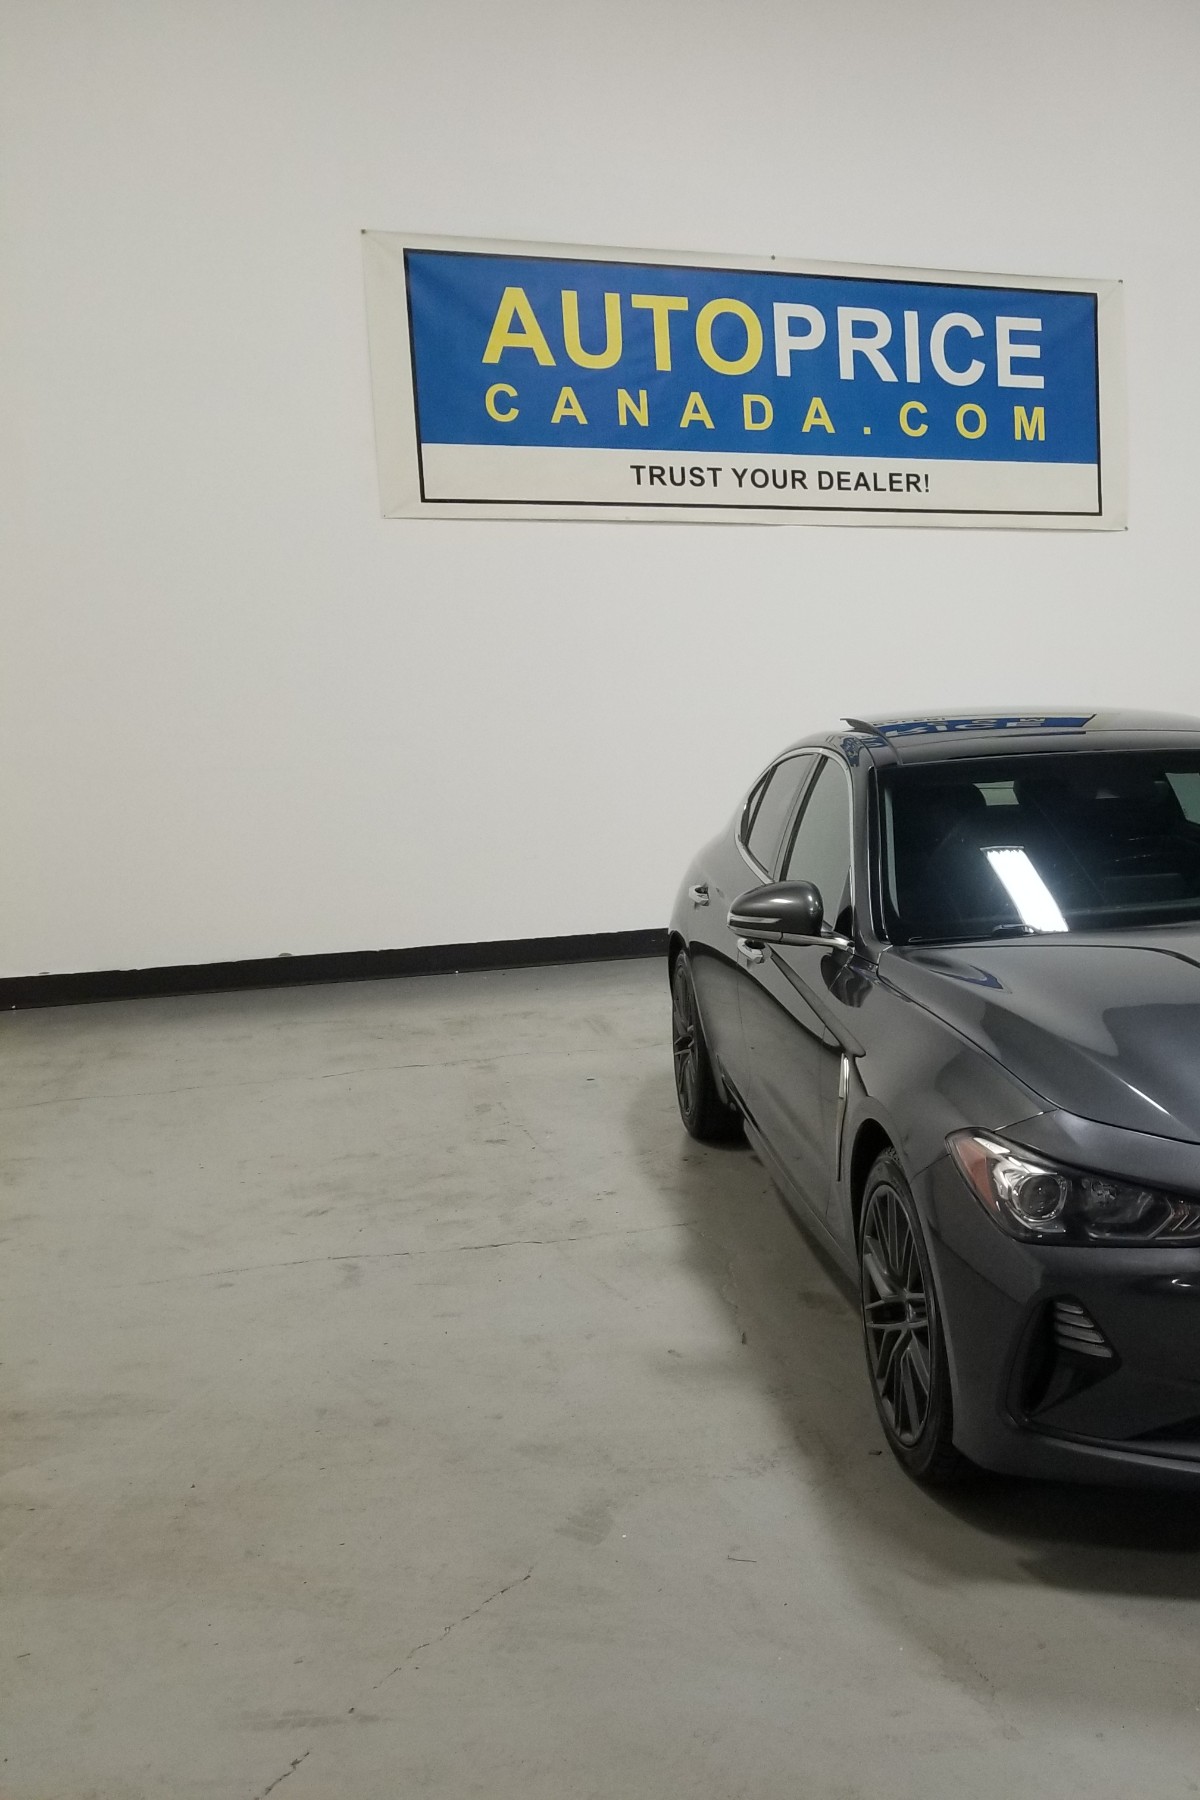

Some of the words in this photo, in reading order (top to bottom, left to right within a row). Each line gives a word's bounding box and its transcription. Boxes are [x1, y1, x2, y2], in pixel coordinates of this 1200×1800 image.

[482, 286, 1045, 389] AUTOPRICE
[484, 383, 1046, 441] CANADA.COM
[630, 465, 722, 488] TRUST
[730, 467, 808, 490] YOUR
[817, 470, 930, 493] DEALER!
